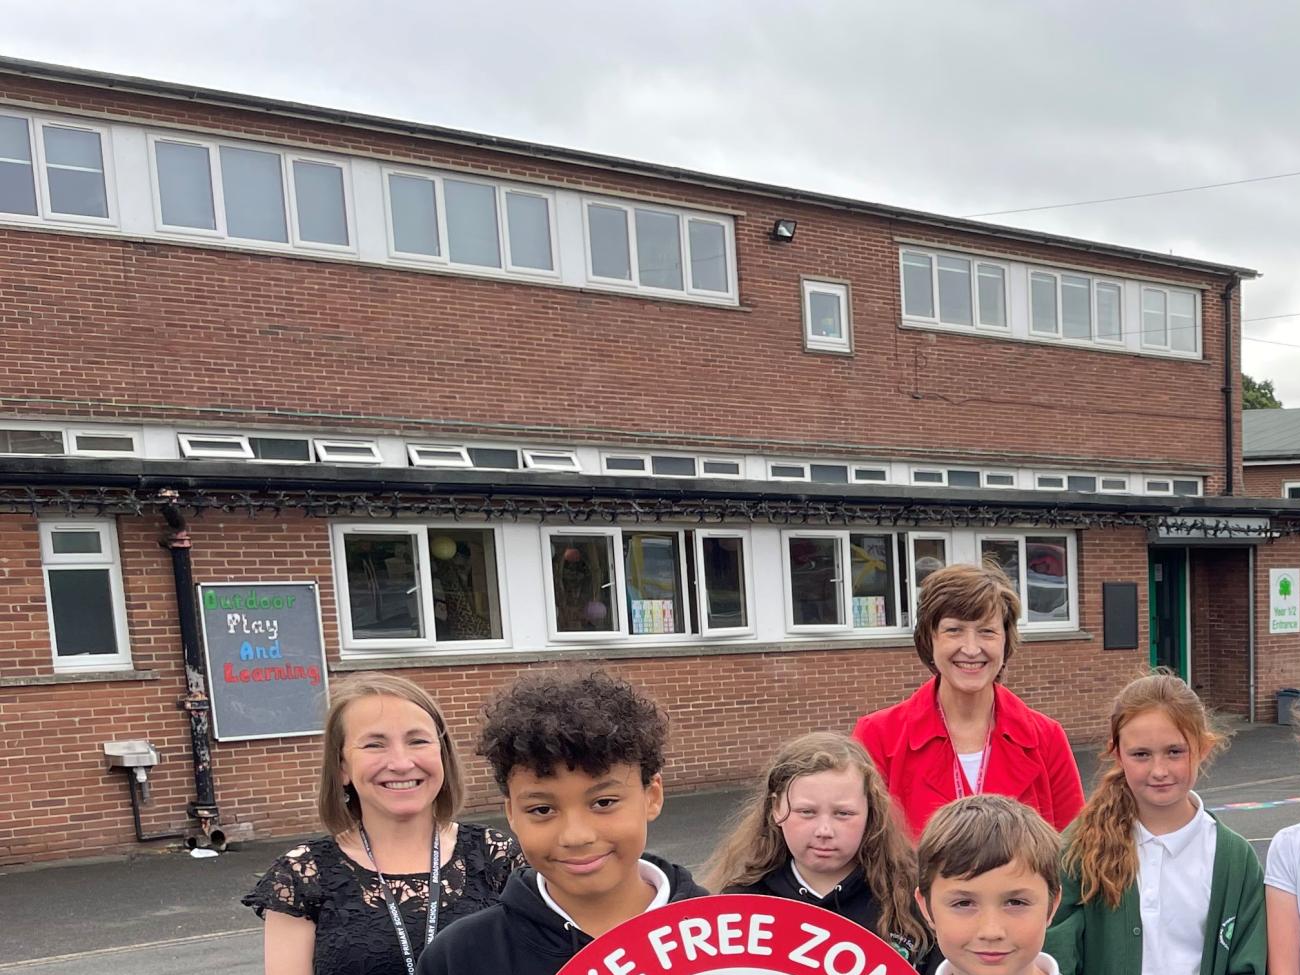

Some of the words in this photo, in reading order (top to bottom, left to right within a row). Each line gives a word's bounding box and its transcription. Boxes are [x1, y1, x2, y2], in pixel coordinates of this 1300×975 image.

[203, 589, 296, 610] Outdoor
[226, 612, 279, 640] Play
[239, 640, 283, 661] And
[223, 662, 321, 686] Learning
[390, 901, 402, 926] SCHOOL
[429, 901, 437, 925] SCHOOL
[648, 912, 776, 970] FREE
